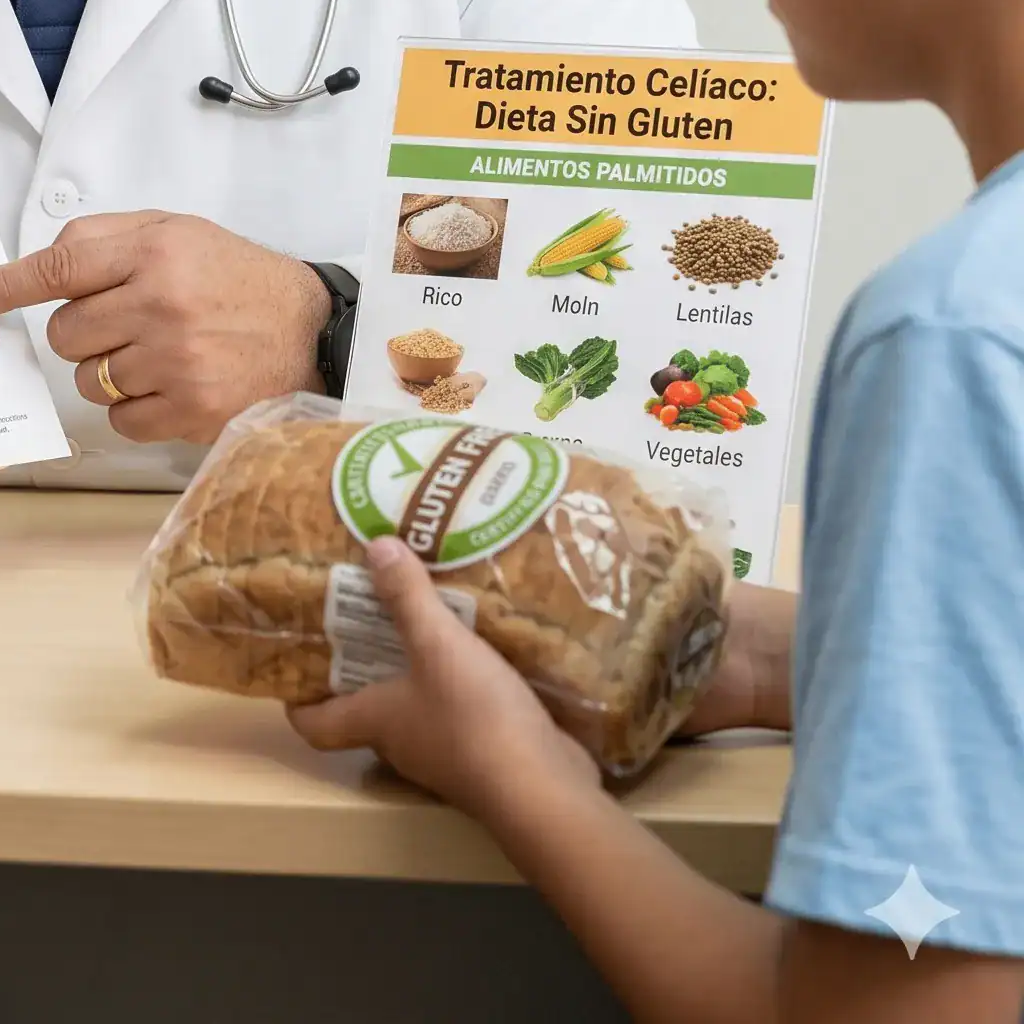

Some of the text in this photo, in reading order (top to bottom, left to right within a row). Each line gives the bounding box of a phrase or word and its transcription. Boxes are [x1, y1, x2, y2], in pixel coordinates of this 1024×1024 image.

[443, 59, 778, 102] Tratamiento Celíaco:
[475, 100, 733, 141] Dieta Sin Gluten
[470, 155, 728, 188] ALIMENTOS PALMITIDOS
[422, 285, 463, 307] Rico
[551, 294, 600, 317] Moln
[676, 302, 754, 327] Lentilas
[645, 439, 744, 469] Vegetales
[406, 454, 474, 552] GLUTEN
